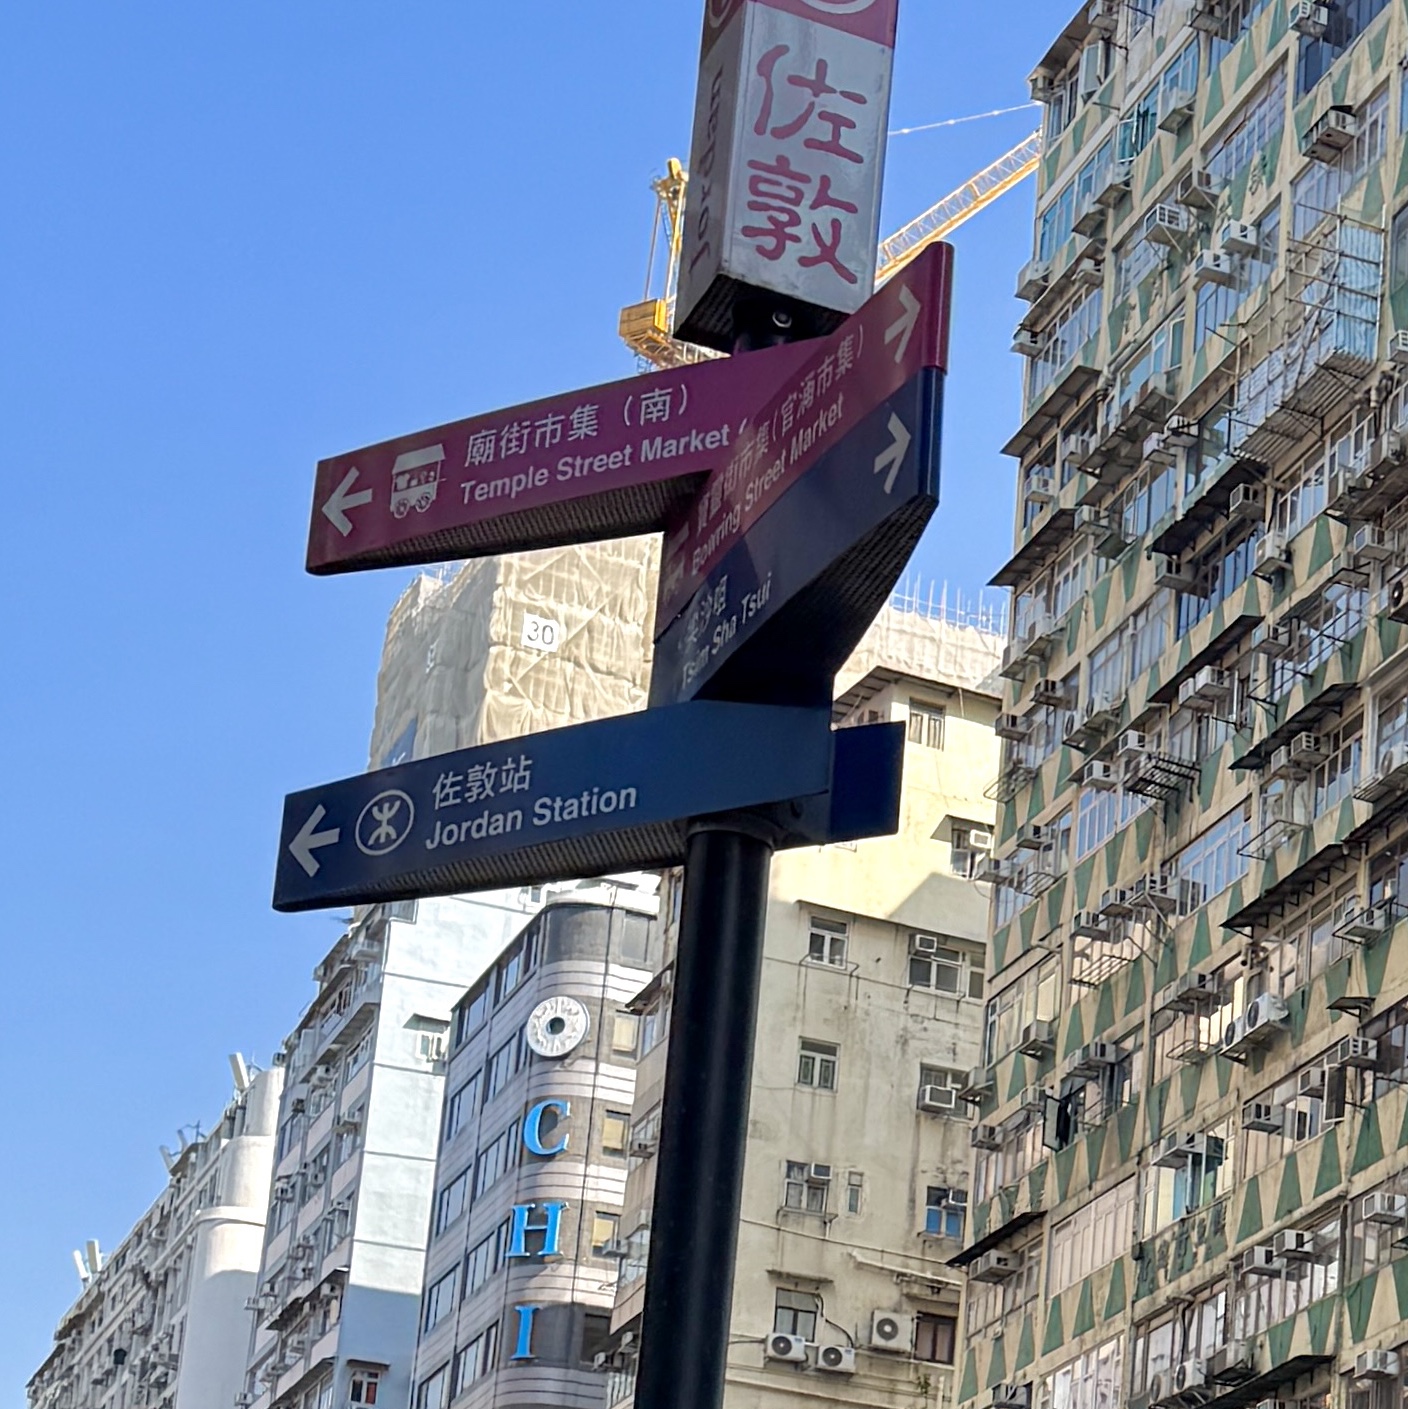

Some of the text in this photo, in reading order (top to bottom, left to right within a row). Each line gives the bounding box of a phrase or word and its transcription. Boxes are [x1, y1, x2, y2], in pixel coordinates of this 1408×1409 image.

[741, 44, 868, 285] 佐敦
[460, 466, 549, 506] Temple
[556, 444, 633, 481] Street
[640, 424, 730, 463] Market
[691, 392, 845, 576] Bowring Street Market
[526, 620, 555, 646] 30
[682, 571, 773, 690] Tsim Sha Tsui
[425, 786, 638, 851] Jordan Station
[432, 753, 533, 812] 佐敦站
